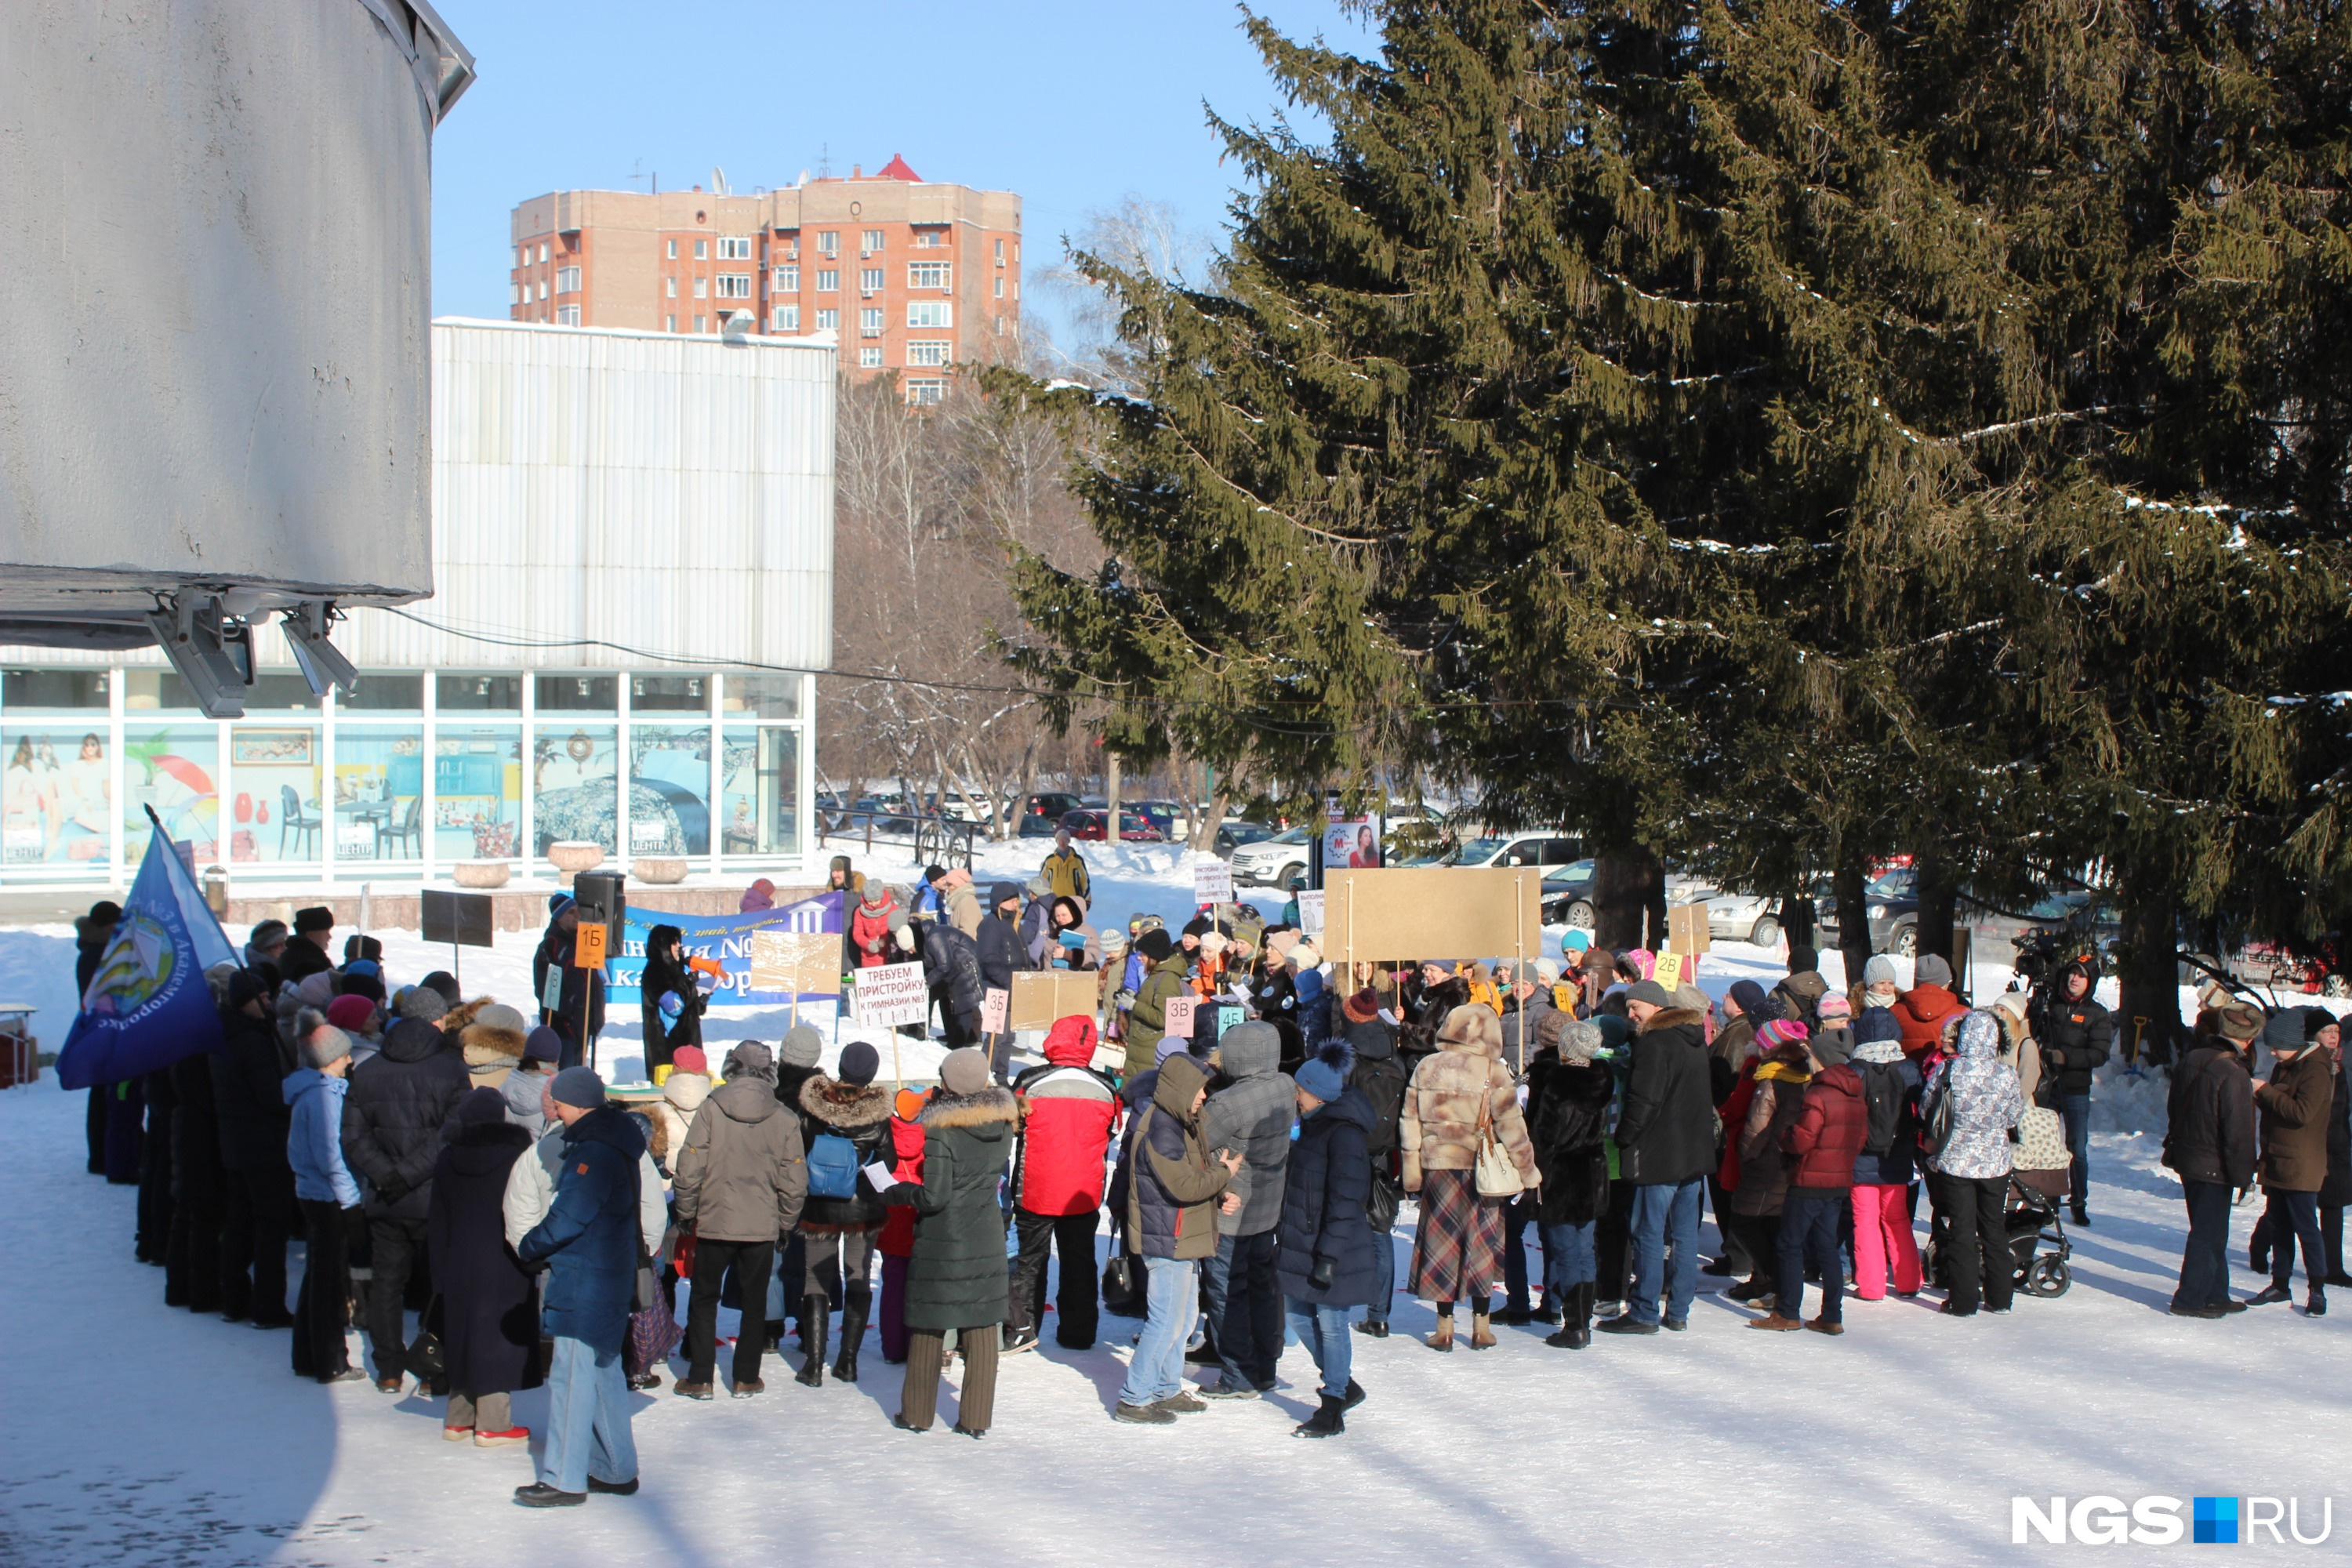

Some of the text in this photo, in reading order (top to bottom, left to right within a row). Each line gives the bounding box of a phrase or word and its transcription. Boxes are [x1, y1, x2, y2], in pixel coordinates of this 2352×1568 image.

[337, 844, 372, 855] ЦЕНТР
[631, 841, 665, 851] ЦЕНТР
[583, 930, 601, 947] 1Б
[1659, 956, 1677, 973] 2В
[867, 967, 912, 982] ТРЕБУЕМ
[858, 978, 924, 998] ПРИСТРОЙКУ
[868, 996, 910, 1011] ГИМНАЗИИ
[989, 995, 1004, 1011] 3Б
[1171, 1003, 1189, 1018] 3В
[1223, 1013, 1240, 1027] 4Б
